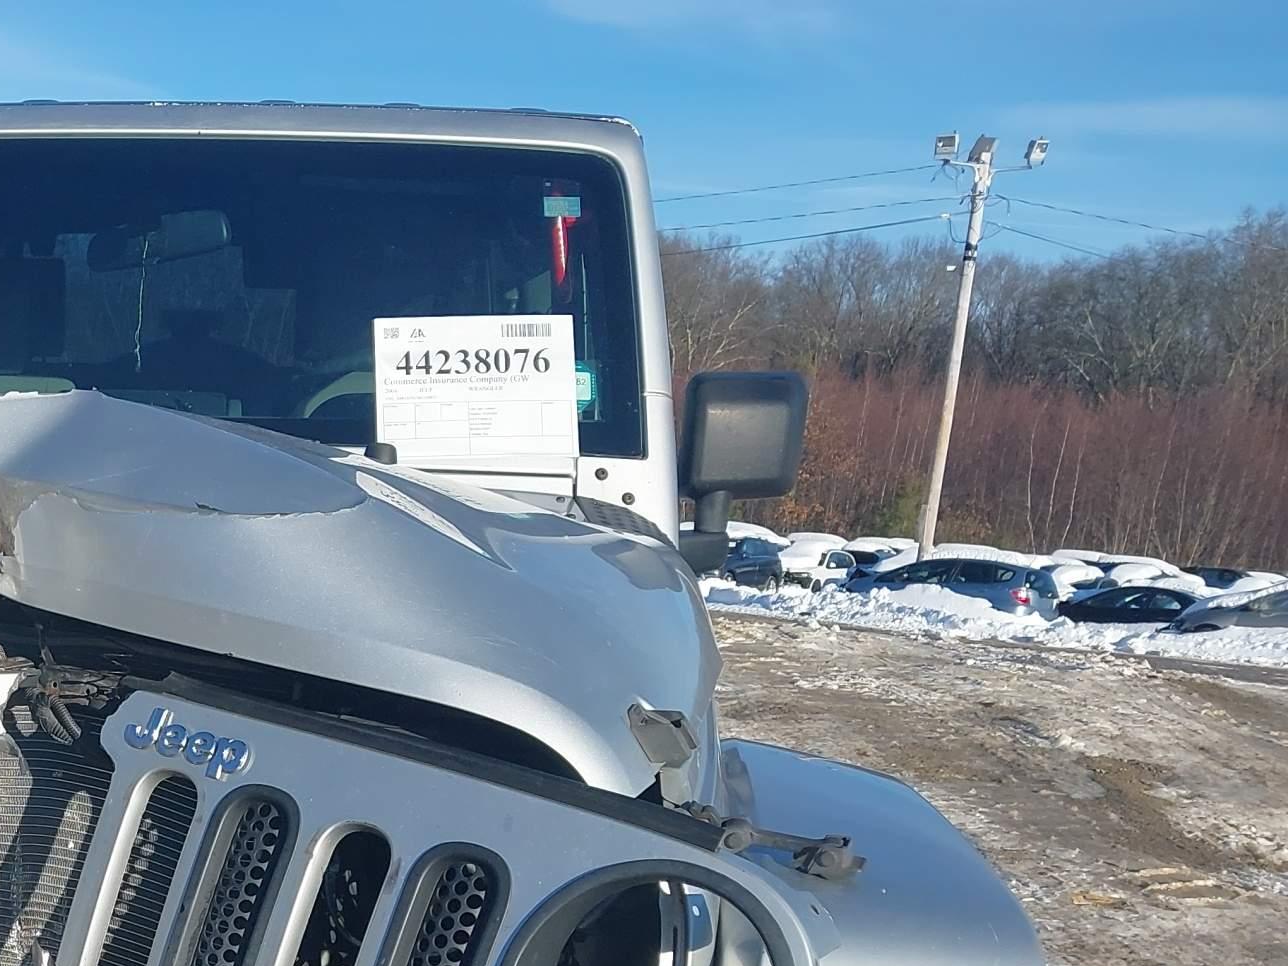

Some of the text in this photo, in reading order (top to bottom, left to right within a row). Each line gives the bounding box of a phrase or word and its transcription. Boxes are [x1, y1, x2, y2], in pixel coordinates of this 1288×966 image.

[396, 348, 550, 375] 44238076
[430, 376, 467, 384] Insurance
[469, 375, 508, 385] Company
[510, 374, 530, 383] (GW
[123, 707, 253, 782] Jeep
